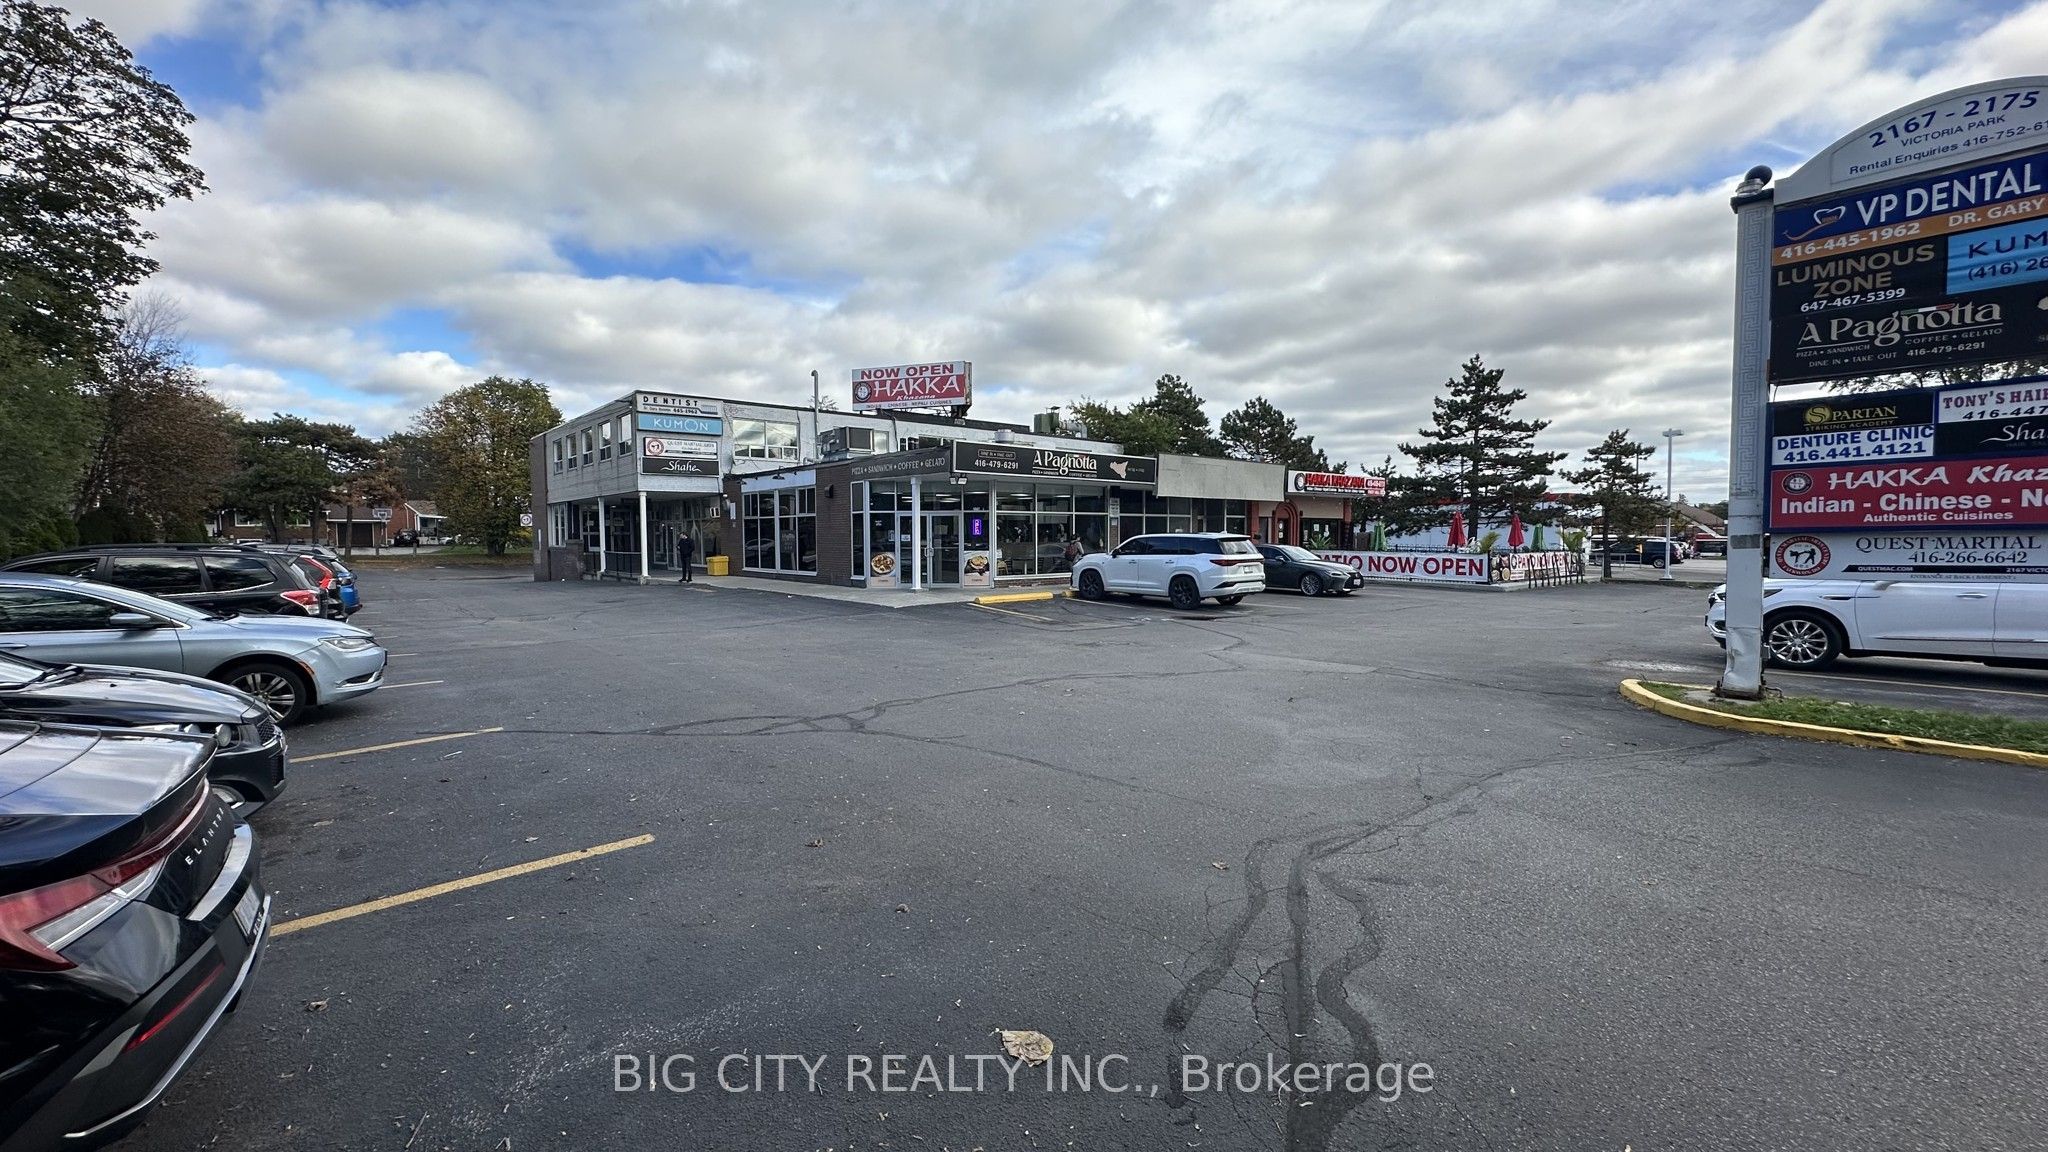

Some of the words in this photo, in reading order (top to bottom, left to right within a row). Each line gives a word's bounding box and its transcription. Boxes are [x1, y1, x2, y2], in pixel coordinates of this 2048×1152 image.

[1869, 110, 1937, 148] 2167
[1963, 90, 2040, 117] 2175
[1901, 125, 1963, 147] VICTORIA
[1967, 114, 2006, 131] PARK
[1850, 157, 1891, 175] Rental
[1895, 143, 1958, 164] Enquiries
[1856, 193, 1898, 226] VP
[1906, 163, 2042, 217] DENTAL
[1781, 222, 1921, 259] 416-445-1962
[1949, 211, 1981, 228] DR.
[1987, 198, 2045, 219] GARY
[1968, 231, 2048, 259] KUM
[1777, 244, 1935, 286] LUMINOUS
[1968, 261, 2019, 281] (416)
[1813, 271, 1892, 299] ZONE
[1800, 288, 1906, 312] 647-467-5399
[1798, 322, 1822, 345] A
[1830, 301, 2001, 347] Pagnotta
[1904, 335, 1947, 345] COFFEE
[1961, 328, 2003, 338] GELATO
[1796, 350, 1818, 358] PIZZA
[1827, 344, 1870, 355] SANDWICH
[1907, 341, 1985, 357] 416-479-6291
[1809, 359, 1829, 368] DINE
[1832, 358, 1841, 366] IN
[1852, 354, 1873, 363] TAKE
[1877, 352, 1898, 360] OUT
[861, 368, 900, 379] NOW
[906, 364, 954, 377] OPEN
[873, 375, 960, 397] HAKKA
[643, 396, 698, 407] DENTIST
[1943, 391, 2005, 409] TONY'S
[653, 418, 709, 432] KUMON
[1809, 406, 1897, 423] SPARTAN
[1805, 423, 1847, 432] STRIKING
[1850, 419, 1894, 428] ACADEMY
[1777, 431, 1861, 450] DENTURE
[1867, 425, 1935, 442] CLINIC
[1033, 450, 1043, 466] A
[1044, 451, 1097, 475] Pagnotta
[1784, 441, 1926, 463] 416.441.4121
[897, 460, 919, 470] COFFEE
[924, 457, 945, 467] GELATO
[975, 459, 1019, 469] 416-479-6291
[1828, 467, 1949, 490] HAKKA
[1781, 497, 1855, 514] Indian
[1879, 493, 1992, 511] Chinese
[1863, 512, 1937, 523] Authentic
[1942, 511, 2013, 521] Cuisines
[1855, 536, 1929, 553] QUEST
[1935, 535, 2042, 550] MARTIAL
[1320, 555, 1363, 570] ATIO
[1368, 556, 1418, 574] NOW
[1423, 556, 1483, 577] OPEN
[1909, 551, 2027, 564] 416-266-6642
